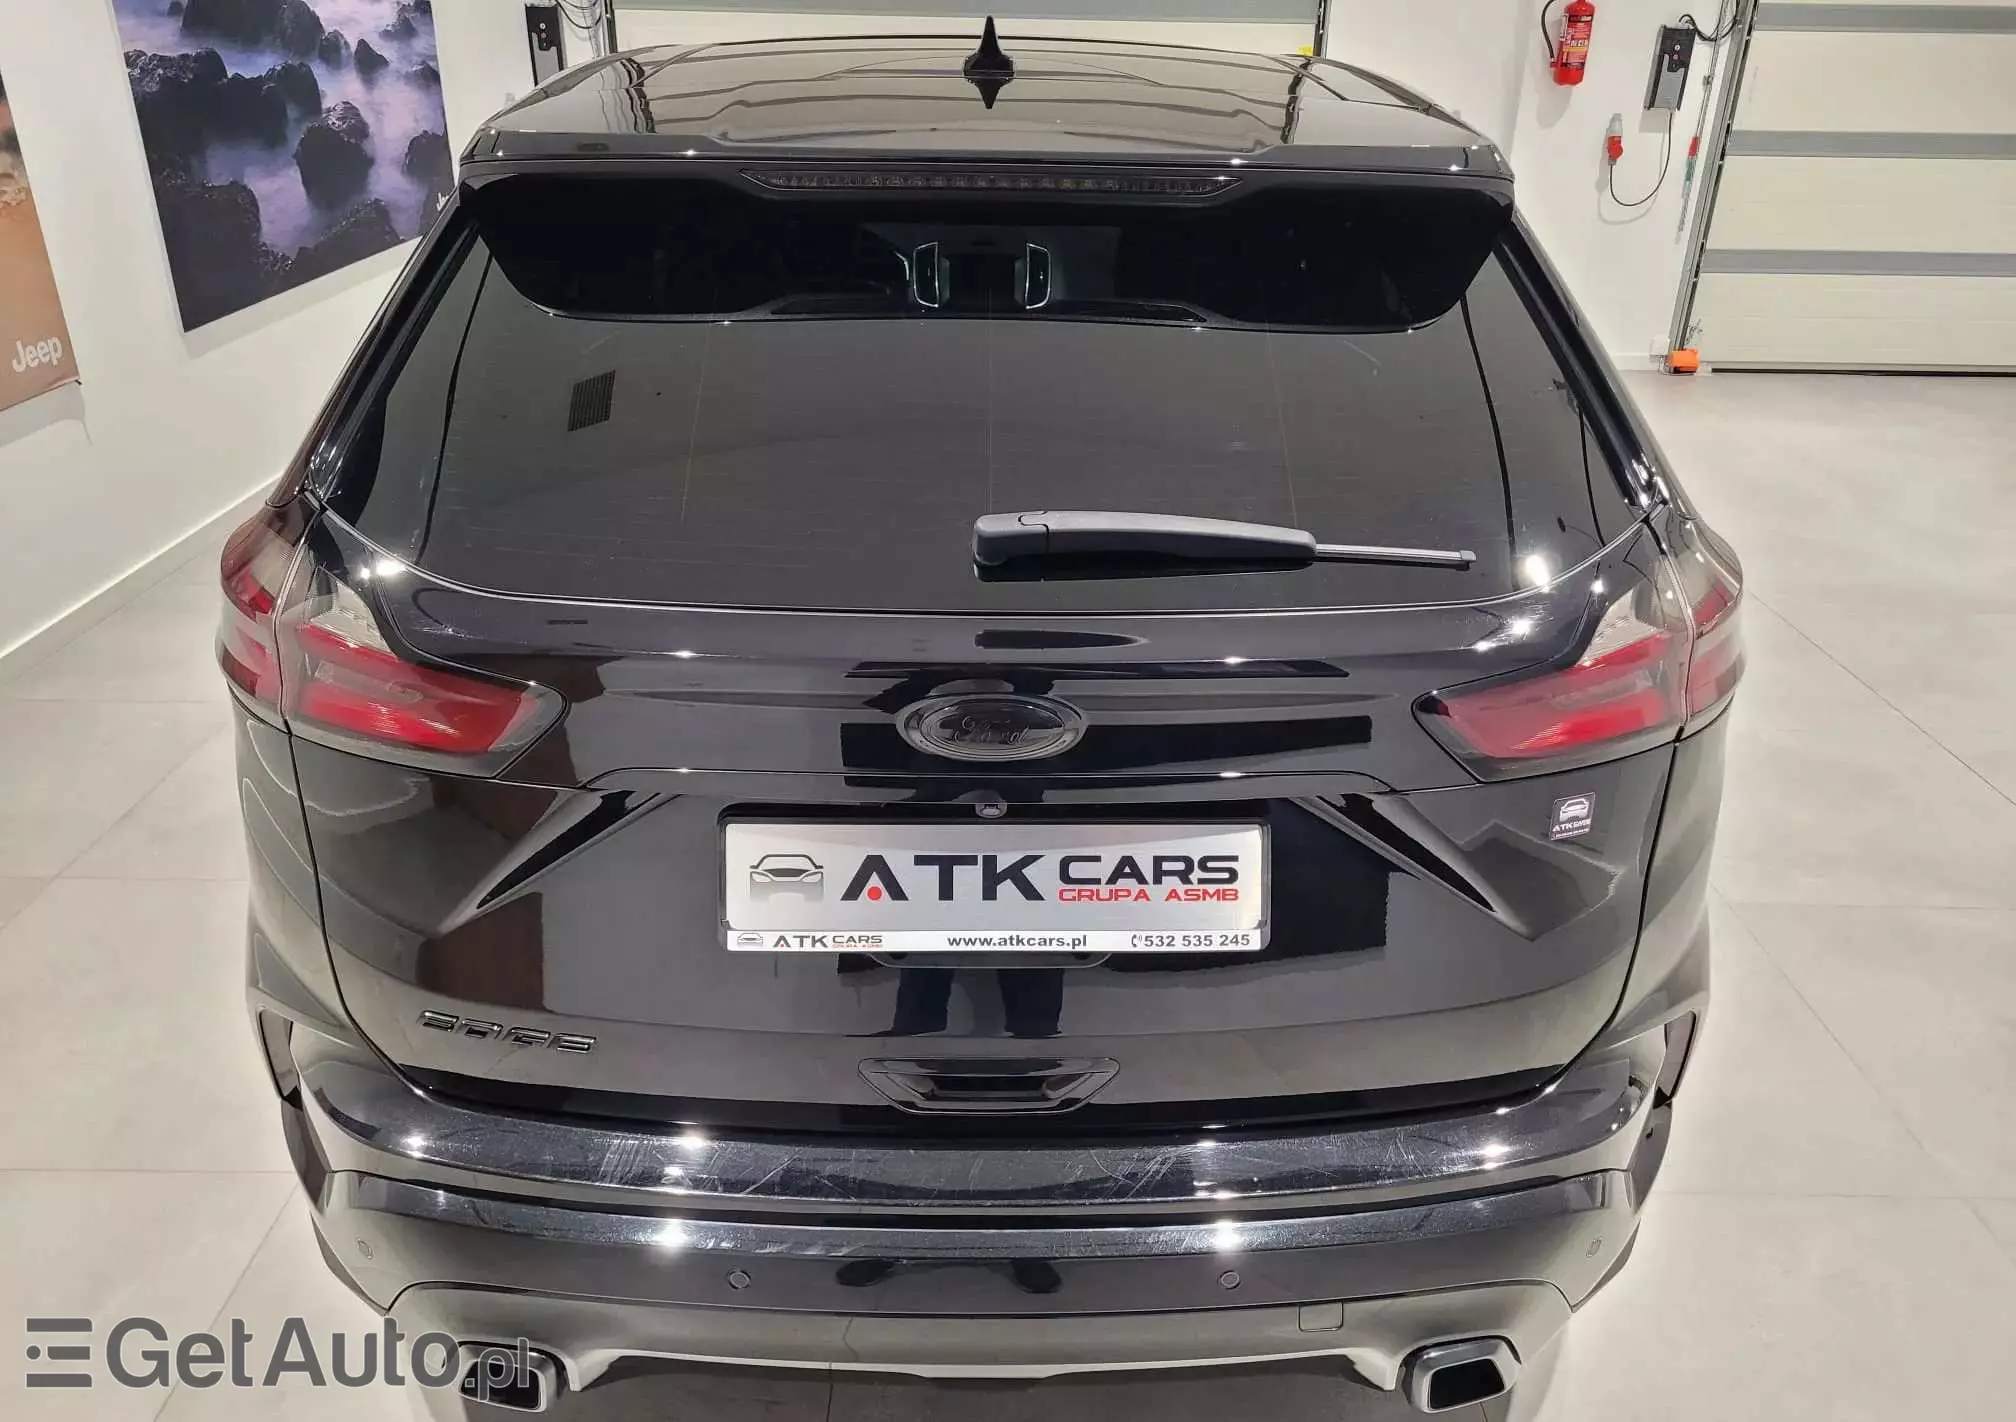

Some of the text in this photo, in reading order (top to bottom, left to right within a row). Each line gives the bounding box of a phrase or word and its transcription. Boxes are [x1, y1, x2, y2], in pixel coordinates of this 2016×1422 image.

[12, 336, 63, 373] Jeep
[839, 854, 1239, 901] ATK CARS
[1058, 888, 1239, 902] GRUPA ASMB
[773, 935, 883, 948] ATK CARS
[947, 934, 1088, 947] www.atkcars.pl
[1143, 934, 1250, 947] 532 535 245
[416, 1010, 597, 1054] EDGE
